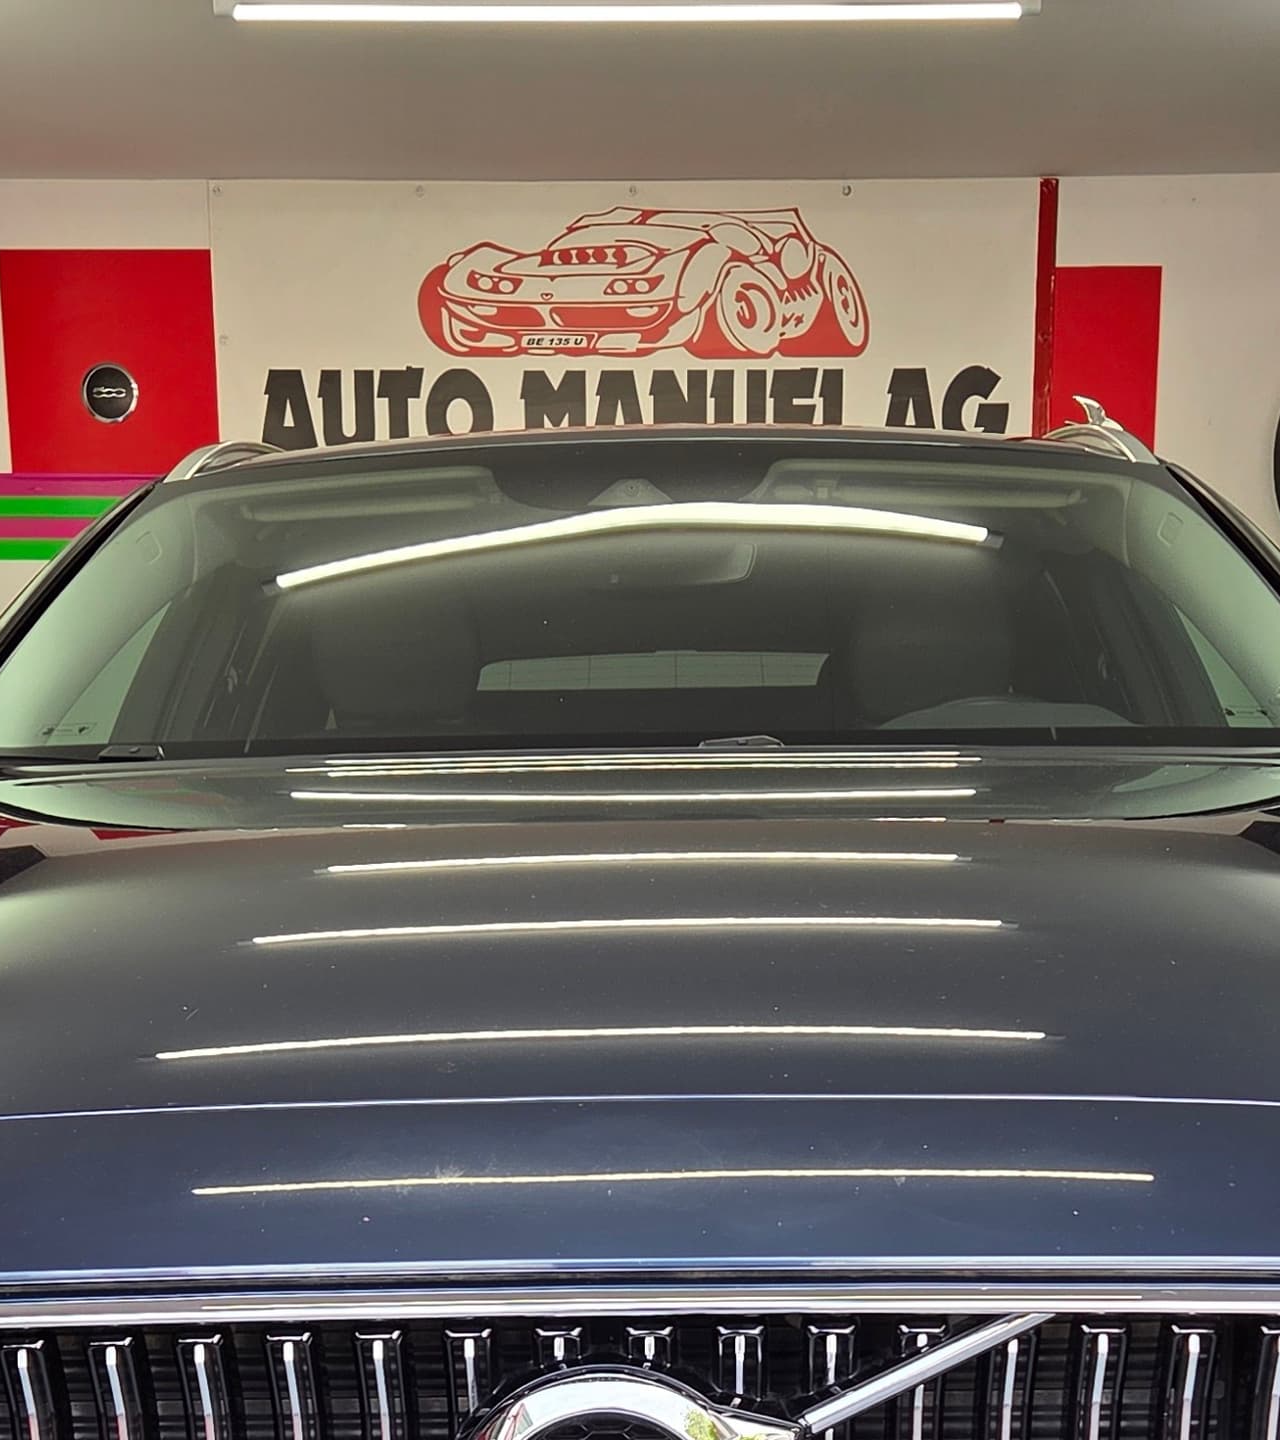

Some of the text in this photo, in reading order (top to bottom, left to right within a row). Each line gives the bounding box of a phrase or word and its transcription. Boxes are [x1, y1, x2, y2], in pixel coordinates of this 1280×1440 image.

[526, 337, 544, 346] BE
[573, 337, 584, 346] U
[262, 366, 494, 451] AUTO
[885, 365, 1010, 435] AG
